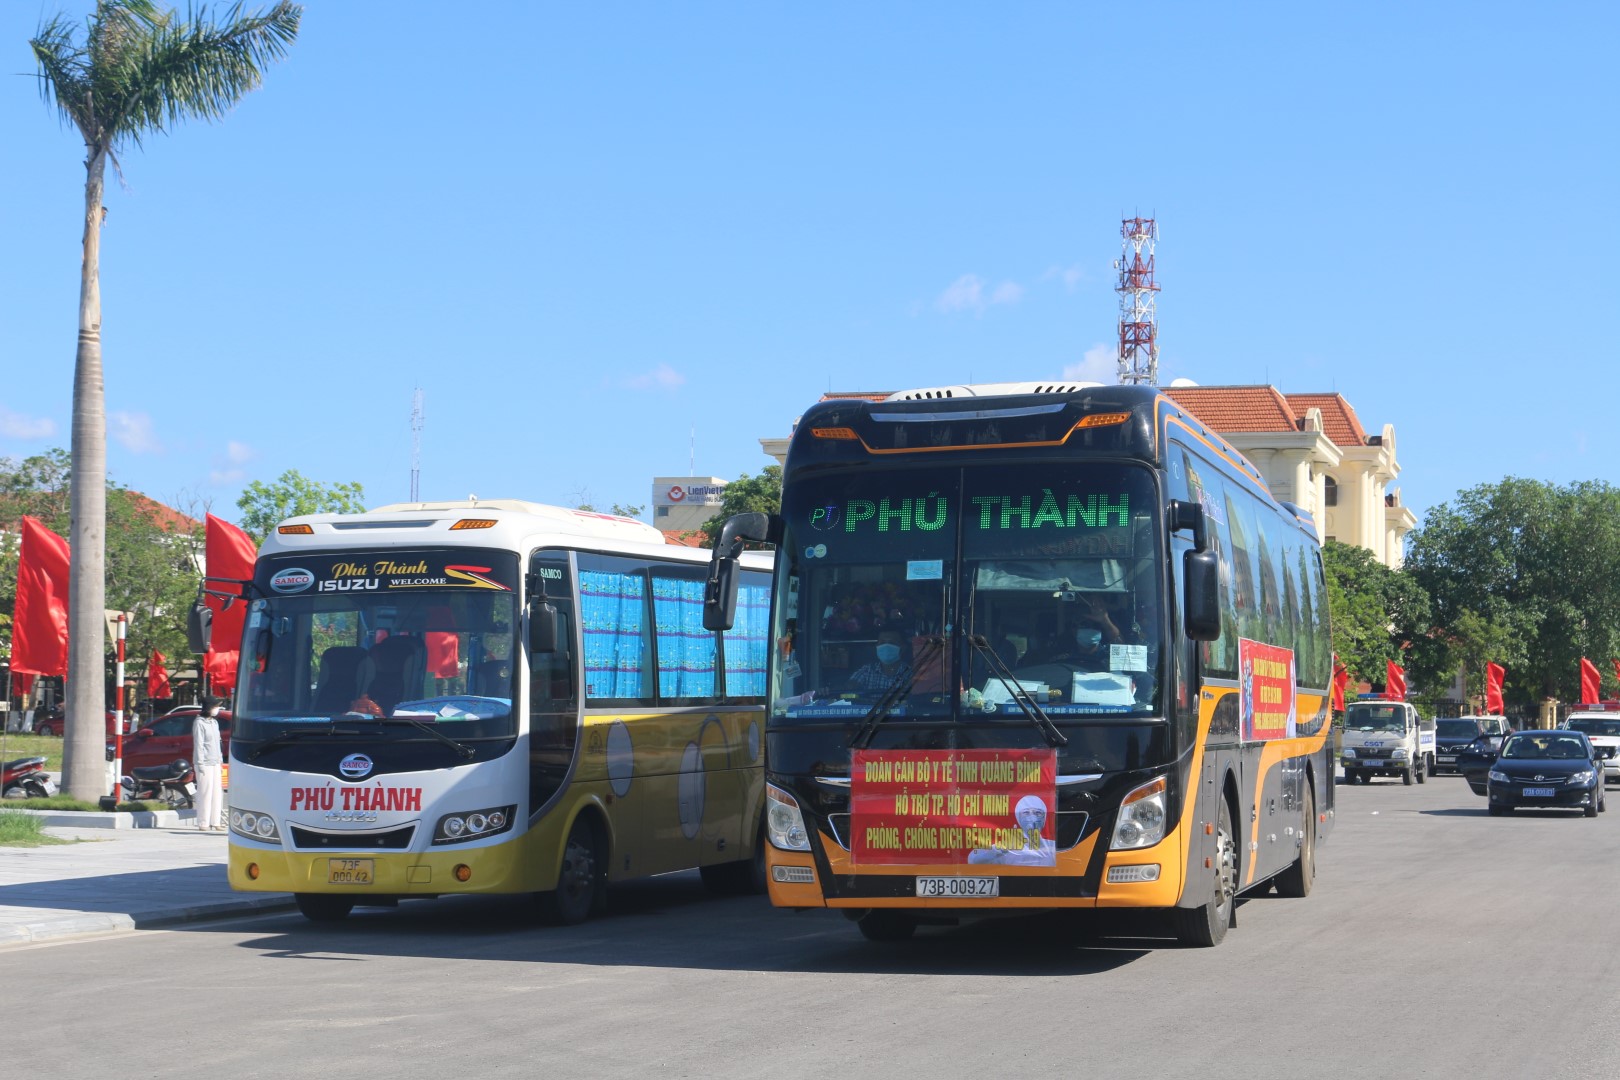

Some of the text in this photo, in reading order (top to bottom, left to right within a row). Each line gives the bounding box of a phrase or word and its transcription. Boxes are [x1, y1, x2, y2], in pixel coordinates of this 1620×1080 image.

[845, 488, 1129, 532] PHÚ THÀNH
[331, 560, 429, 579] Phú Thành
[540, 567, 562, 580] SAMCO
[274, 576, 310, 585] SAMCO
[318, 577, 447, 591] ISUZU WELCOME
[341, 761, 369, 769] SAMCO
[865, 754, 1041, 788] ĐOÀN CÁN BỘ Y TẾ TỈNH QUẢNG BÌNH
[289, 781, 423, 811] PHÚ THÀNH
[895, 786, 1010, 820] HỖ TRỢ TP. HỒ CHÍ MINH
[324, 811, 378, 823] ISUZU
[866, 822, 902, 851] PHÒNG,
[904, 819, 937, 849] CHỐNG
[939, 827, 963, 853] DỊCH
[965, 823, 992, 854] BỆNH
[341, 860, 361, 871] 73F
[333, 872, 368, 882] 000.42
[919, 879, 995, 896] 73B-009.27
